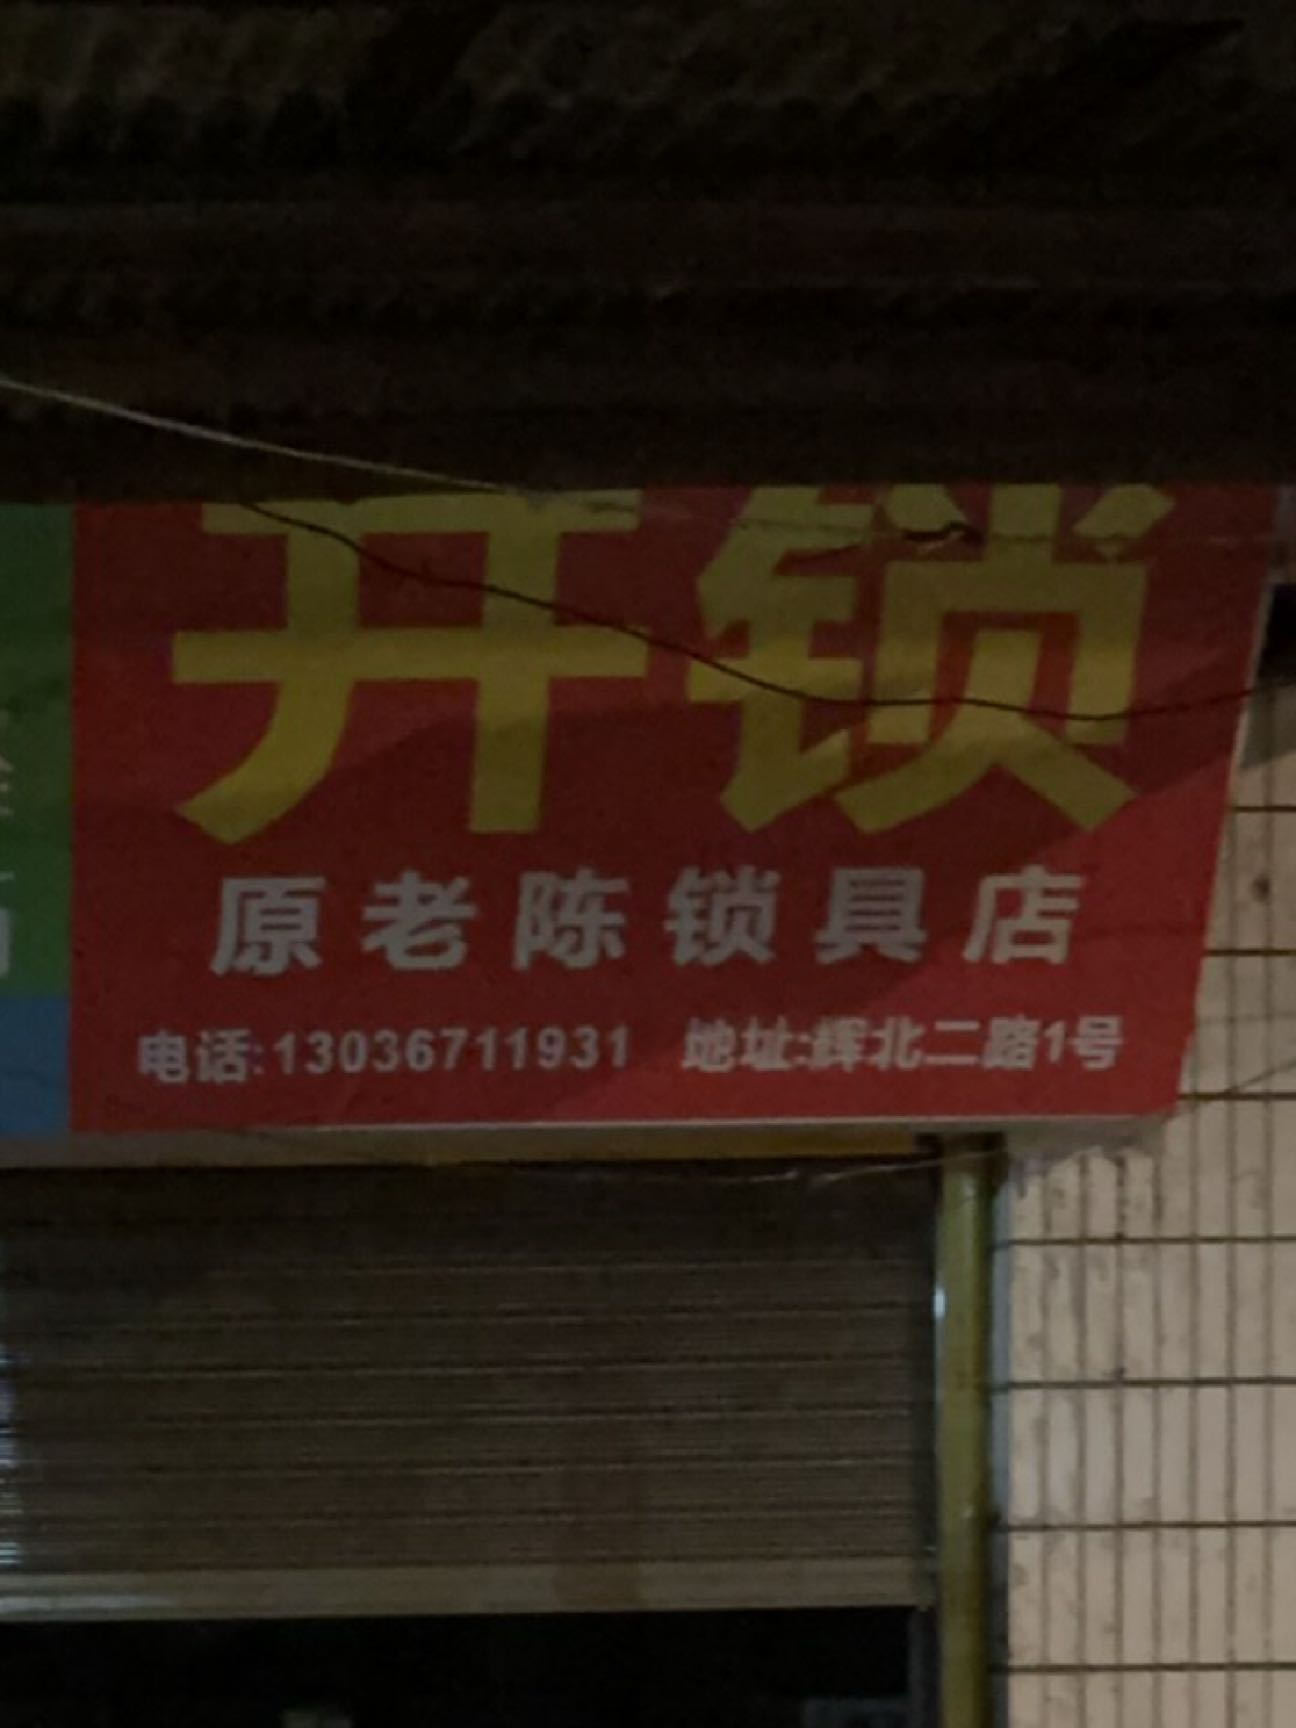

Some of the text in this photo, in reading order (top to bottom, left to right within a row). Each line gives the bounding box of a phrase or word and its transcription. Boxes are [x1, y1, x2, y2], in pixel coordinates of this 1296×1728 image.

[171, 484, 1177, 846] 开锁
[209, 864, 1084, 979] 原老陈锁具店
